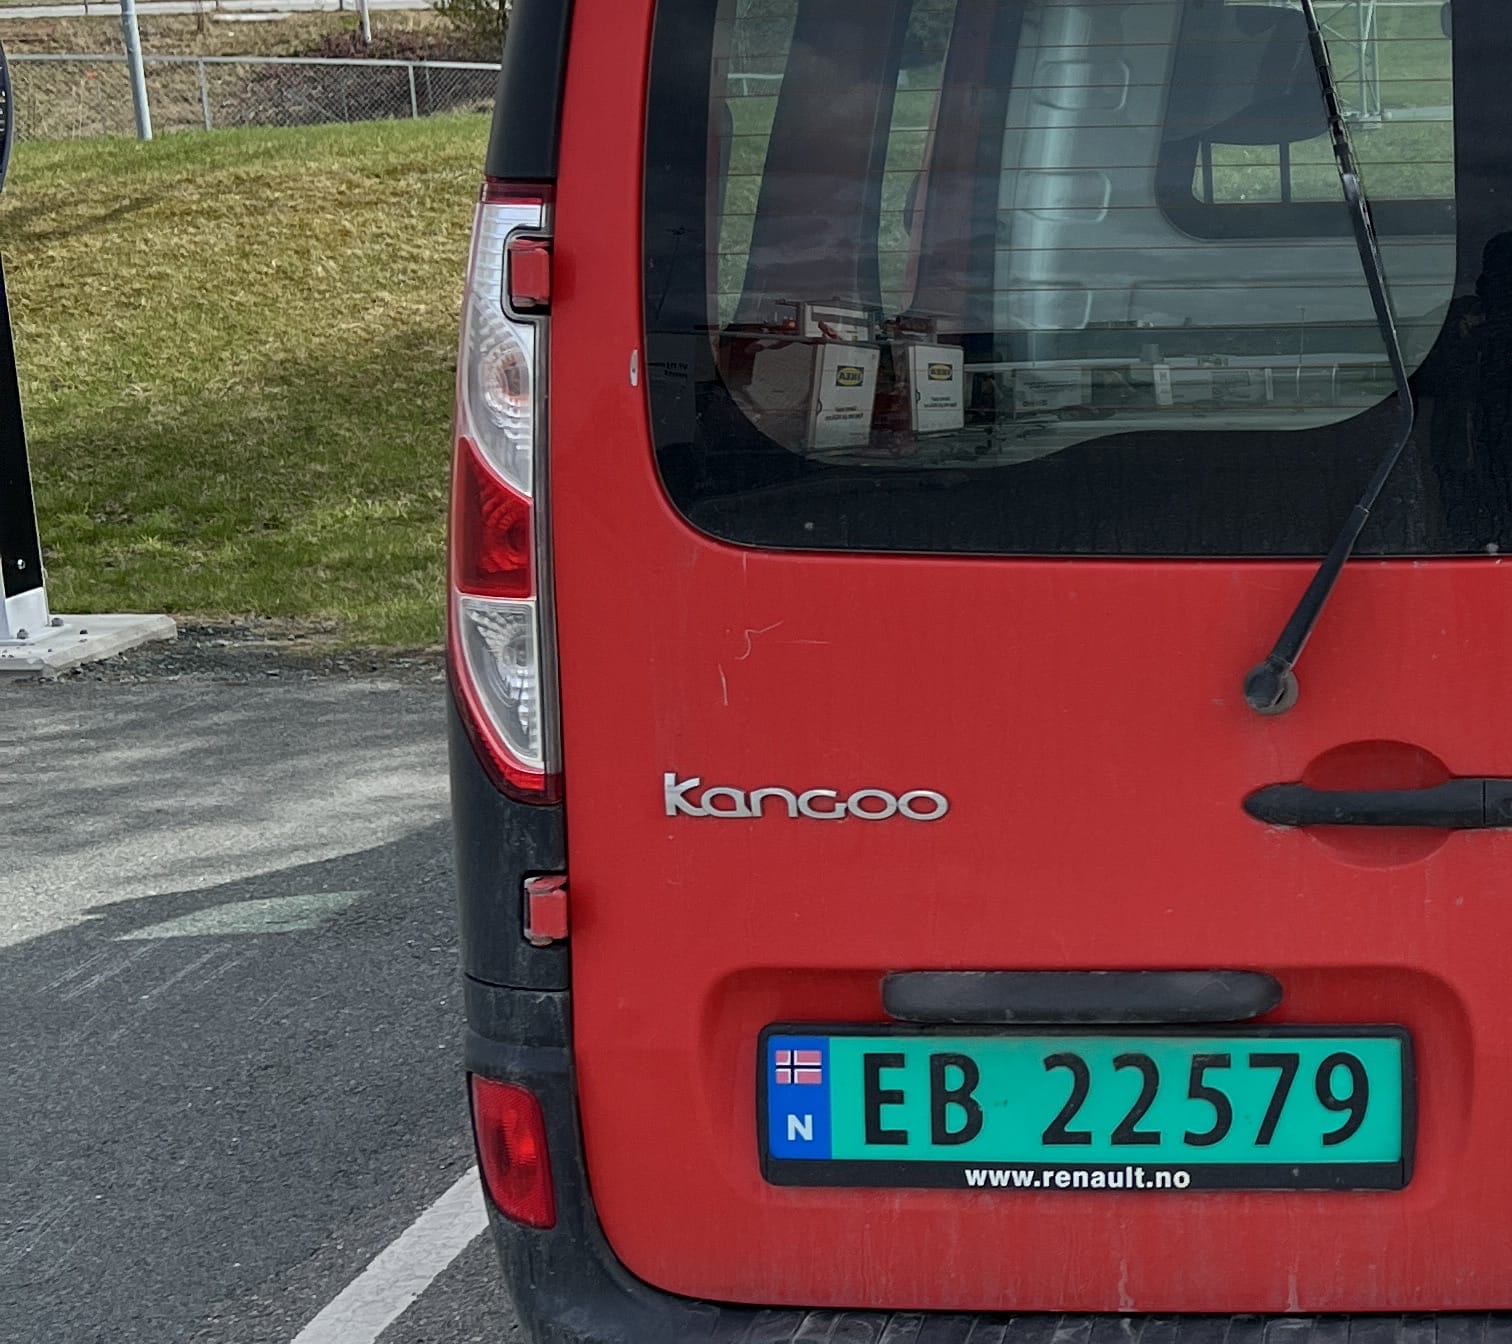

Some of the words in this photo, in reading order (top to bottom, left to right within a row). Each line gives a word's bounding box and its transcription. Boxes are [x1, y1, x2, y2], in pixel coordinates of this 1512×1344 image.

[663, 771, 950, 821] Kangoo
[863, 1052, 985, 1147] EB
[1040, 1051, 1371, 1147] 22579
[786, 1113, 813, 1142] N
[965, 1164, 1191, 1190] www.renault.no
